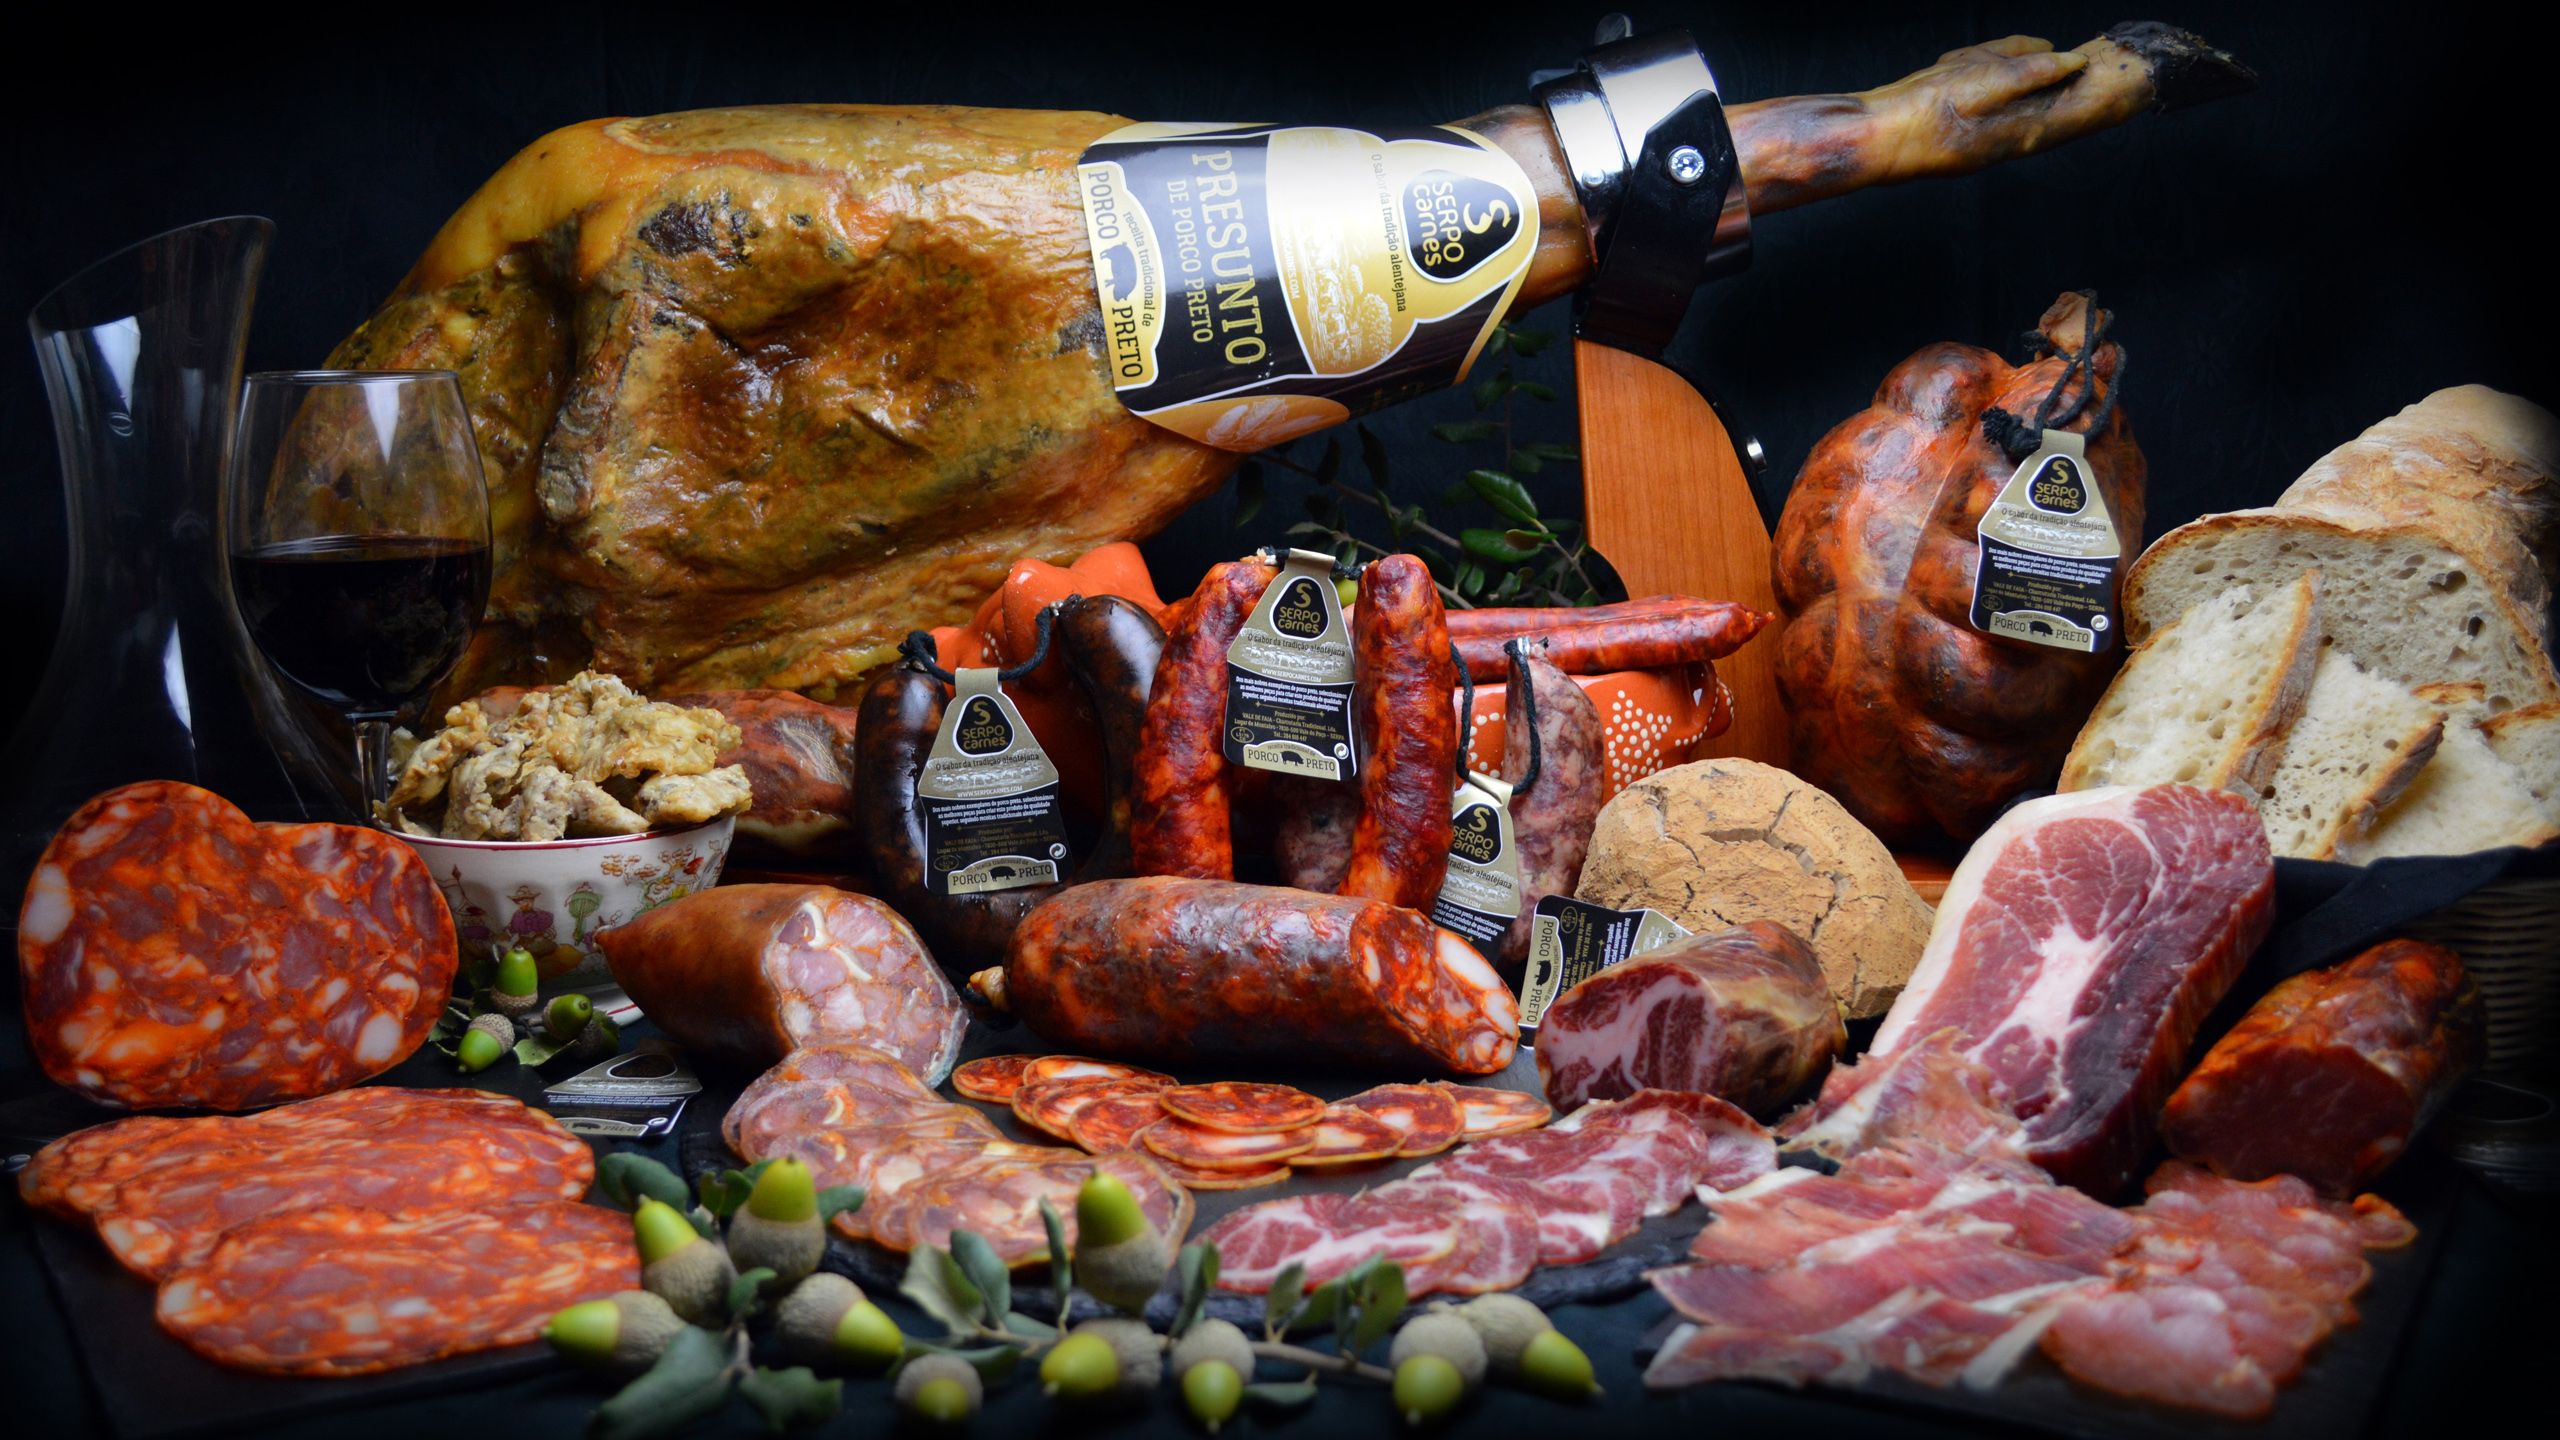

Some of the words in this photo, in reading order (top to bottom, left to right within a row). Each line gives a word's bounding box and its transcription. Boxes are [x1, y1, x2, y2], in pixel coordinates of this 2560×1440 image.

[1167, 179, 1190, 204] DE
[1123, 211, 1145, 248] receita
[1382, 207, 1399, 251] tradição
[1413, 184, 1442, 267] carnes
[1432, 181, 1464, 263] SERPO
[1172, 207, 1202, 272] PORCO
[1192, 150, 1267, 364] PRESUNTO
[1088, 171, 1120, 240] PORCO
[1112, 305, 1144, 378] PRETO
[1138, 249, 1156, 314] tradicional
[1390, 254, 1406, 312] alentejana
[1142, 314, 1155, 327] de
[1184, 278, 1214, 343] PRETO
[2034, 494, 2078, 509] carnes
[2036, 482, 2079, 498] SERPO
[2030, 512, 2038, 520] da
[2040, 514, 2068, 526] tradição
[1278, 618, 1319, 634] carnes
[1280, 606, 1320, 624] SERPO
[1248, 633, 1254, 641] O
[1255, 634, 1272, 645] sabor
[1273, 638, 1281, 646] da
[1282, 639, 1308, 650] tradição
[1994, 617, 2026, 632] PORCO
[2055, 630, 2089, 643] PRETO
[962, 724, 1005, 740] SERPO
[963, 736, 1007, 750] carnes
[936, 763, 942, 771] O
[942, 761, 961, 770] sabor
[972, 756, 1000, 766] tradição
[1248, 749, 1278, 762] PORCO
[1306, 758, 1336, 772] PRETO
[958, 785, 1022, 798] WWW.SERPOCARNES.COM
[1453, 826, 1494, 850] SERPO
[1454, 838, 1490, 860] arnes
[952, 873, 988, 886] PORCO
[1018, 864, 1052, 878] PRETO
[1538, 920, 1554, 956] PORCO
[1526, 988, 1542, 1022] PRETO
